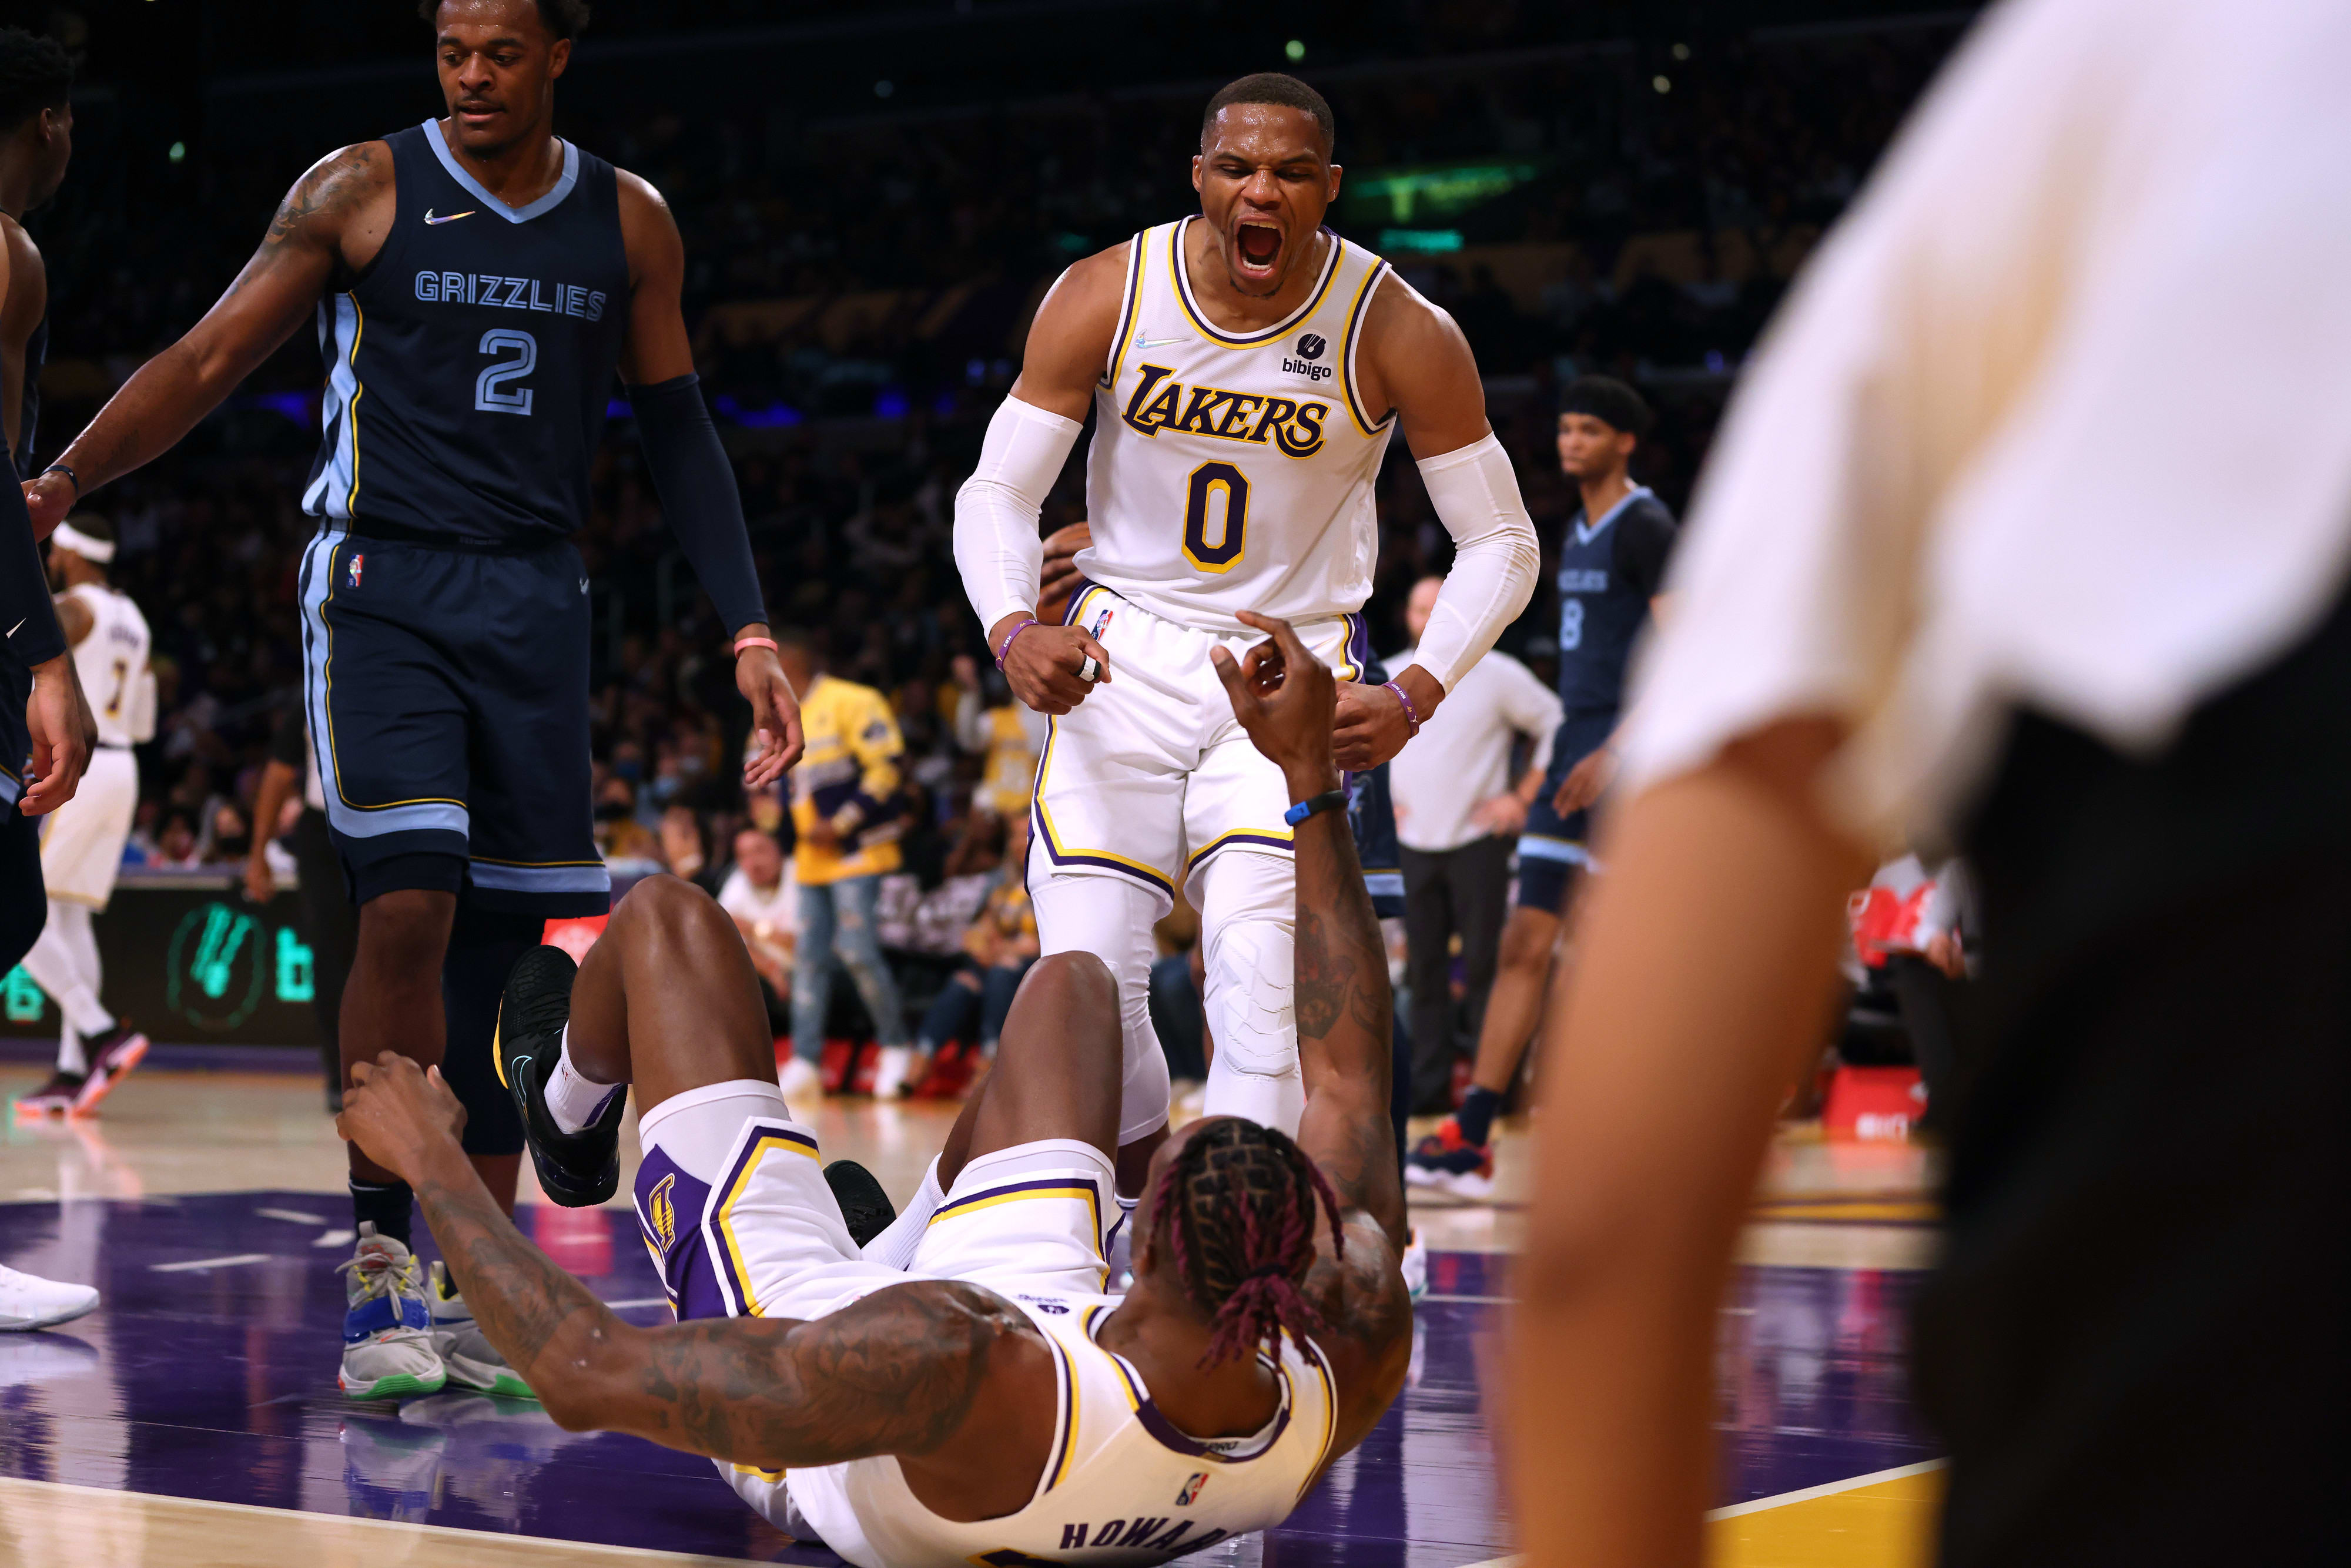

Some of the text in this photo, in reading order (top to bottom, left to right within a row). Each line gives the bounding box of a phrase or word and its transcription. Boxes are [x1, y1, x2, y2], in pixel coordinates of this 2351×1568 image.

[415, 270, 607, 322] GRIZZLIES
[474, 328, 537, 416] 2
[1282, 357, 1332, 381] bibigo
[1121, 361, 1332, 460] LAKERS
[1181, 459, 1252, 574] 0
[1059, 1517, 1241, 1555] HOWAR
